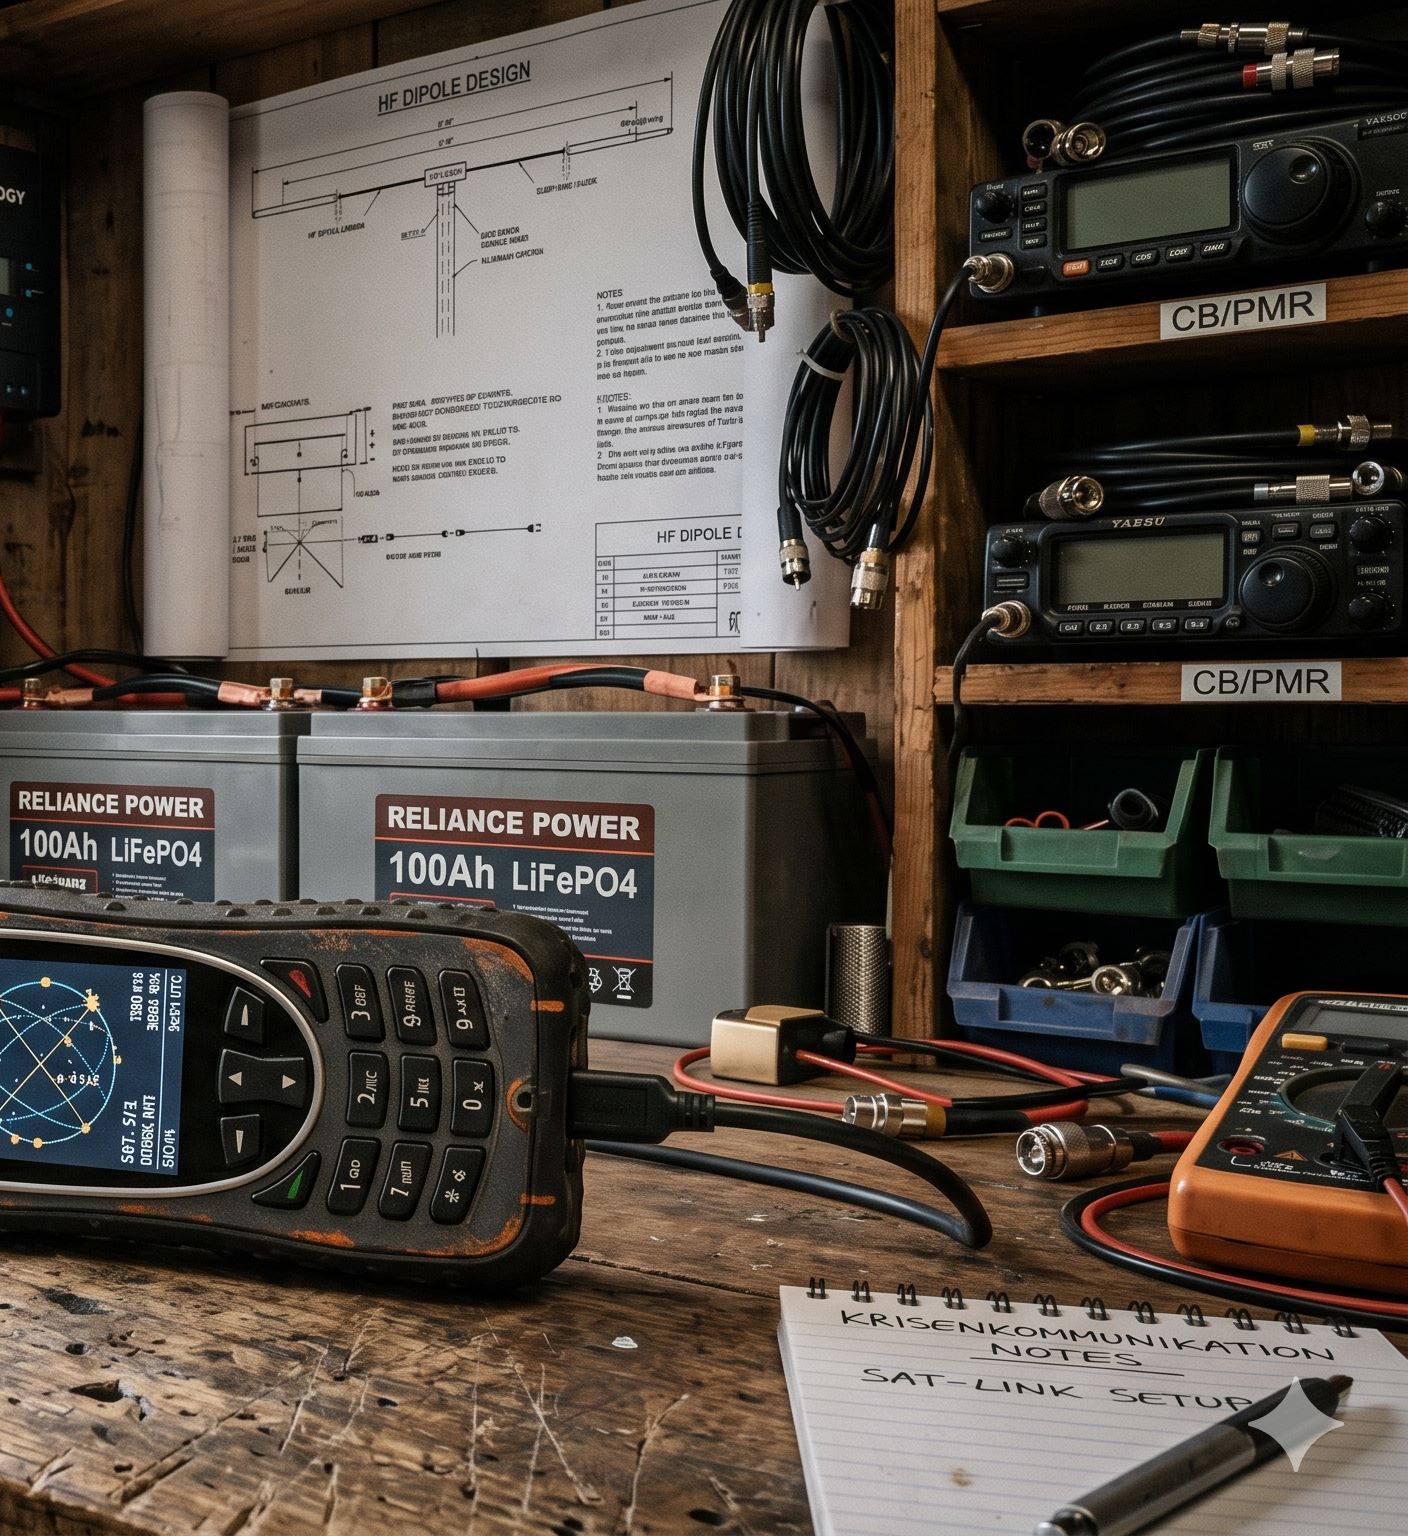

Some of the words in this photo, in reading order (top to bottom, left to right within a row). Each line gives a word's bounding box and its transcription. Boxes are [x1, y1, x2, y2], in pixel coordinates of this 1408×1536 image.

[378, 92, 398, 112] HF
[403, 77, 461, 107] DIPOLE
[466, 60, 531, 92] DESIGN
[596, 288, 624, 300] NOTES
[1172, 291, 1315, 331] CB/PMR
[657, 530, 676, 543] HF
[680, 527, 732, 542] DIPOLE
[1112, 517, 1166, 528] YAESU
[1193, 668, 1330, 695] CB/PMR
[18, 791, 119, 815] RELIANCE
[125, 794, 204, 819] POWER
[388, 805, 524, 835] RELIANCE
[532, 812, 641, 841] POWER
[19, 828, 98, 861] 100Ah
[111, 836, 202, 868] LiFePO4
[389, 850, 495, 890] 100Ah
[512, 860, 638, 899] LiFePO4
[170, 975, 183, 998] UTC
[357, 1090, 376, 1104] 2
[410, 1097, 429, 1108] 5
[391, 1186, 410, 1197] 7
[841, 1310, 1335, 1360] KRISENKOMMUNIKATION
[991, 1343, 1143, 1366] NOTES
[860, 1368, 1083, 1399] SAT-LINK
[1109, 1388, 1253, 1411] SETUP
